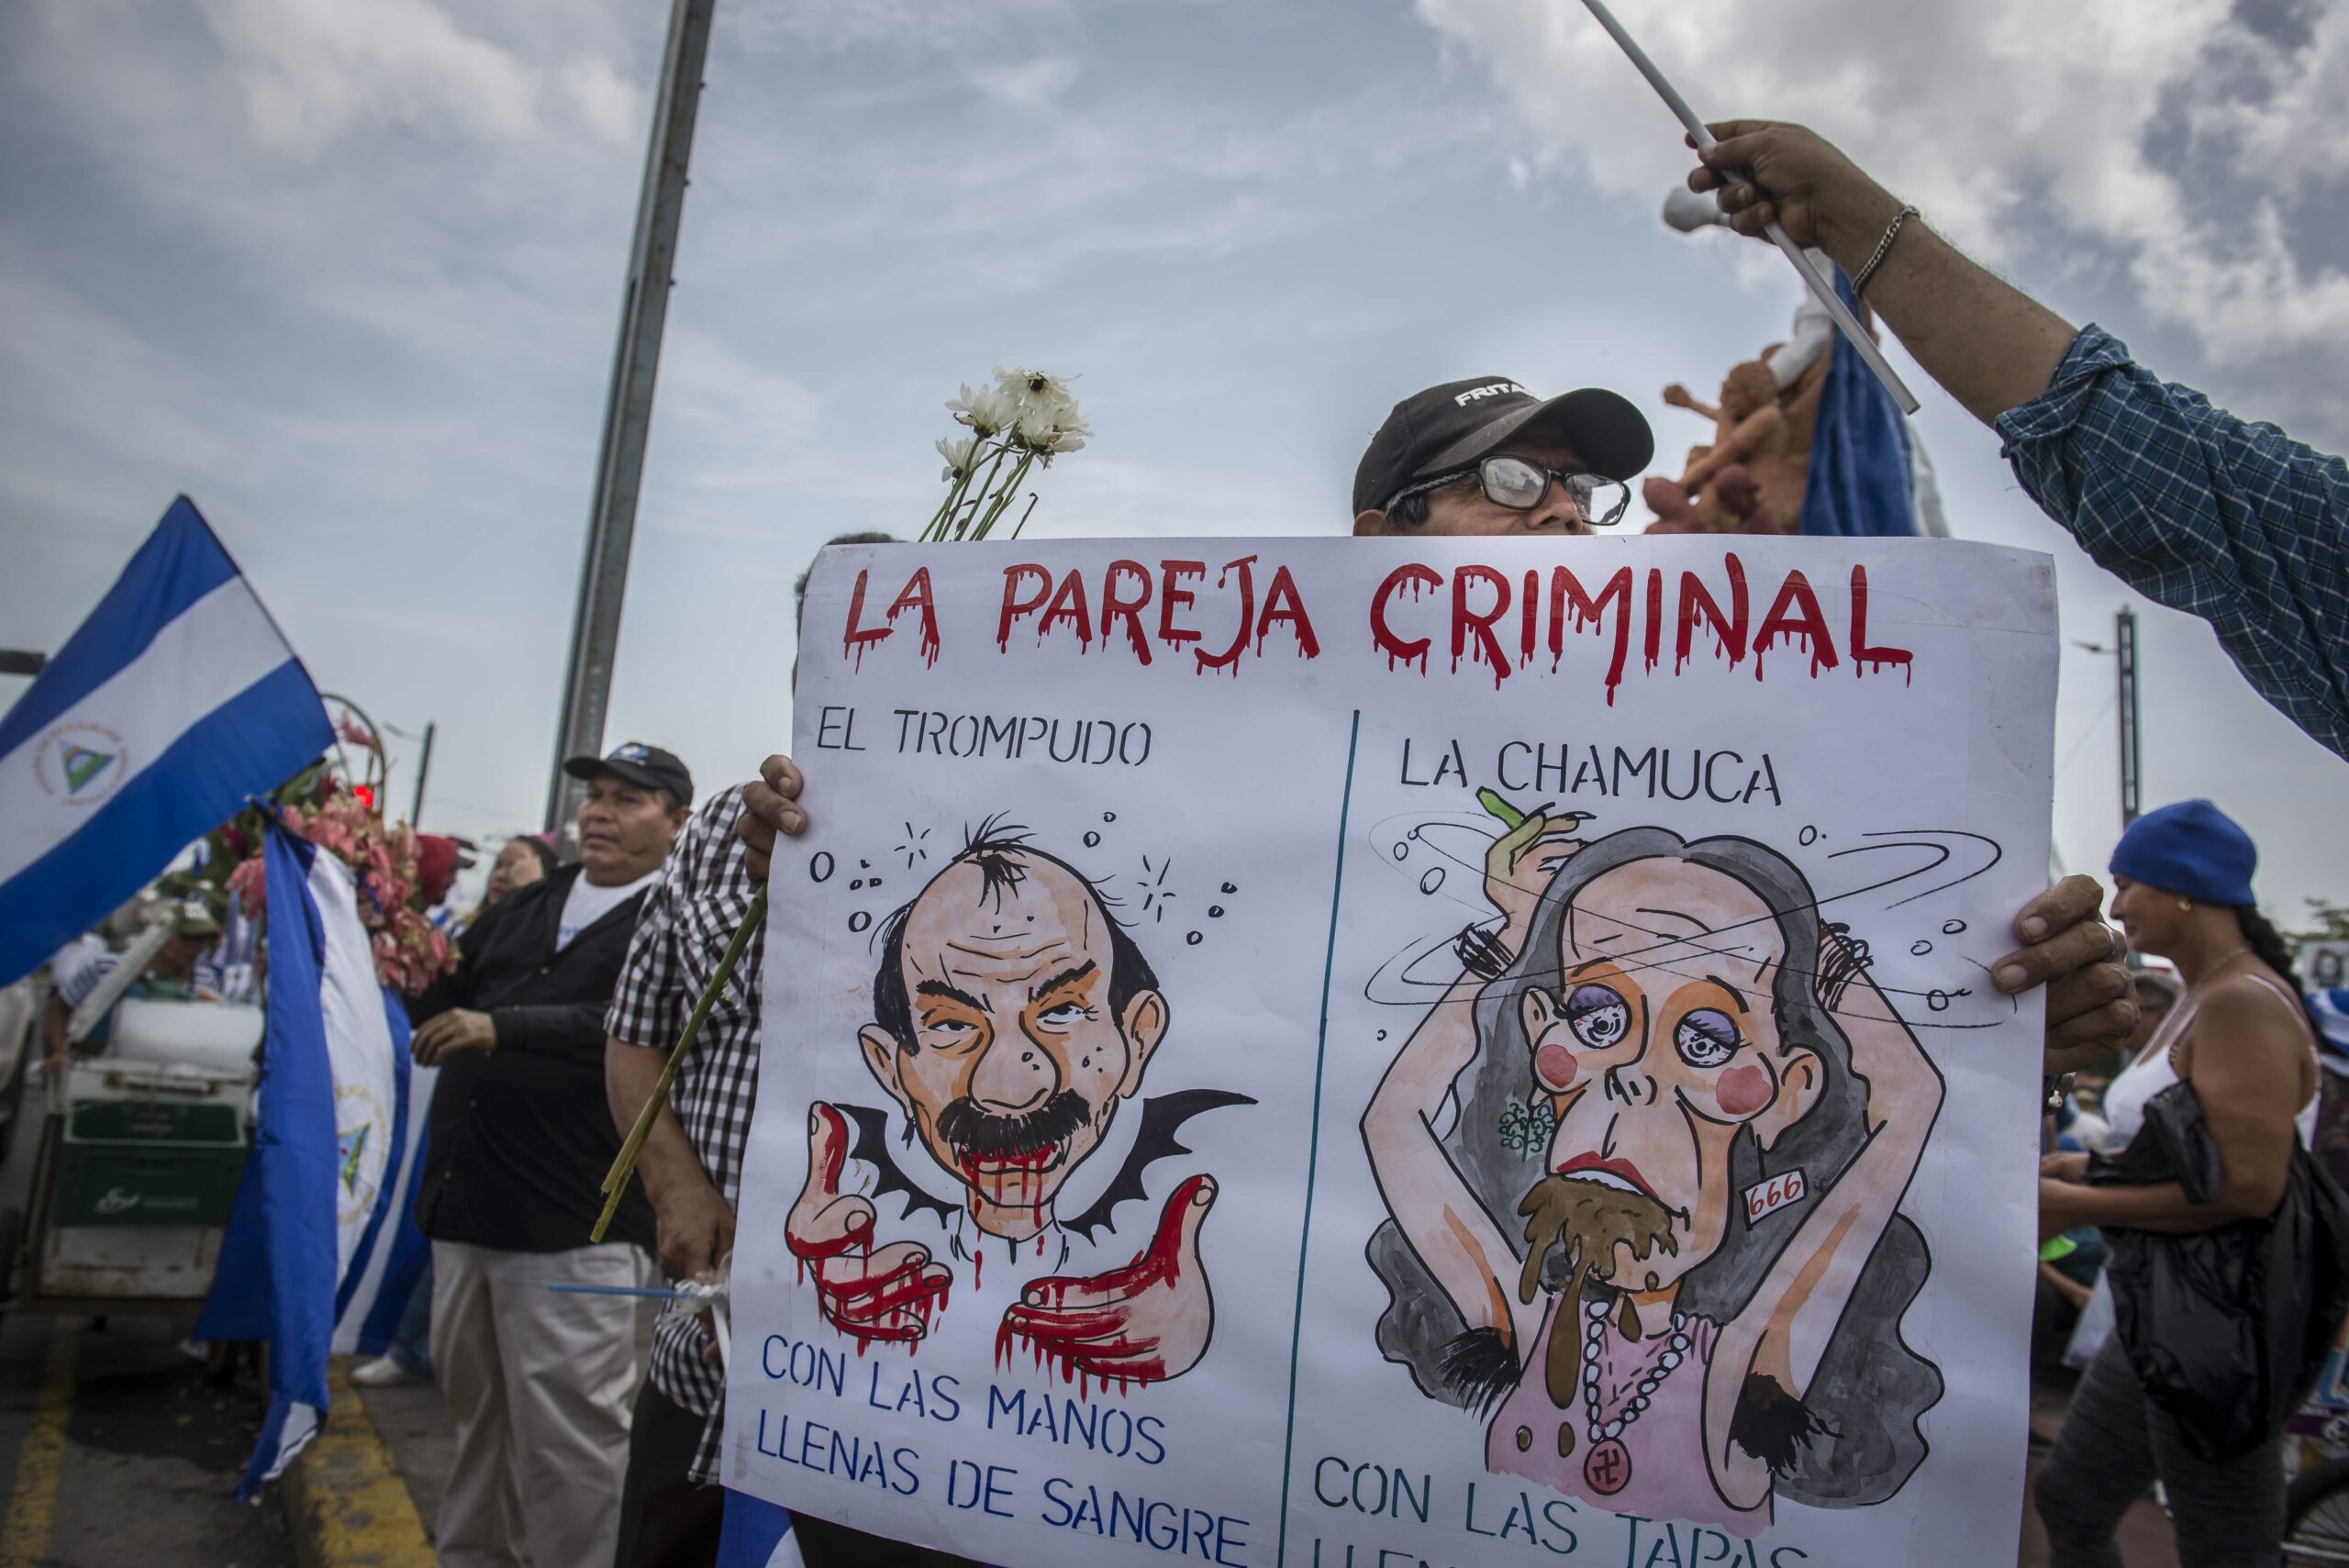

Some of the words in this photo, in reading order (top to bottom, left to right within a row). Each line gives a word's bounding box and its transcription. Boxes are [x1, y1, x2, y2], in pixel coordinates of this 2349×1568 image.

[844, 567, 940, 674] LA
[997, 555, 1320, 679] PAREJA
[1370, 552, 1913, 706] CRIMINAL
[817, 706, 865, 751] EL
[894, 710, 1152, 766] TROMPUDO
[1400, 738, 1468, 787] LA
[1497, 741, 1782, 806] CHAMUCA
[1749, 1173, 1802, 1216] 666
[763, 1335, 845, 1396] CON
[869, 1362, 960, 1421] LAS
[987, 1385, 1165, 1464] MANOS
[757, 1409, 919, 1495] LLENAS
[948, 1460, 1018, 1517] DE
[1041, 1477, 1250, 1568] SANGRE
[1315, 1457, 1431, 1523] CON
[1467, 1483, 1577, 1553] LAS
